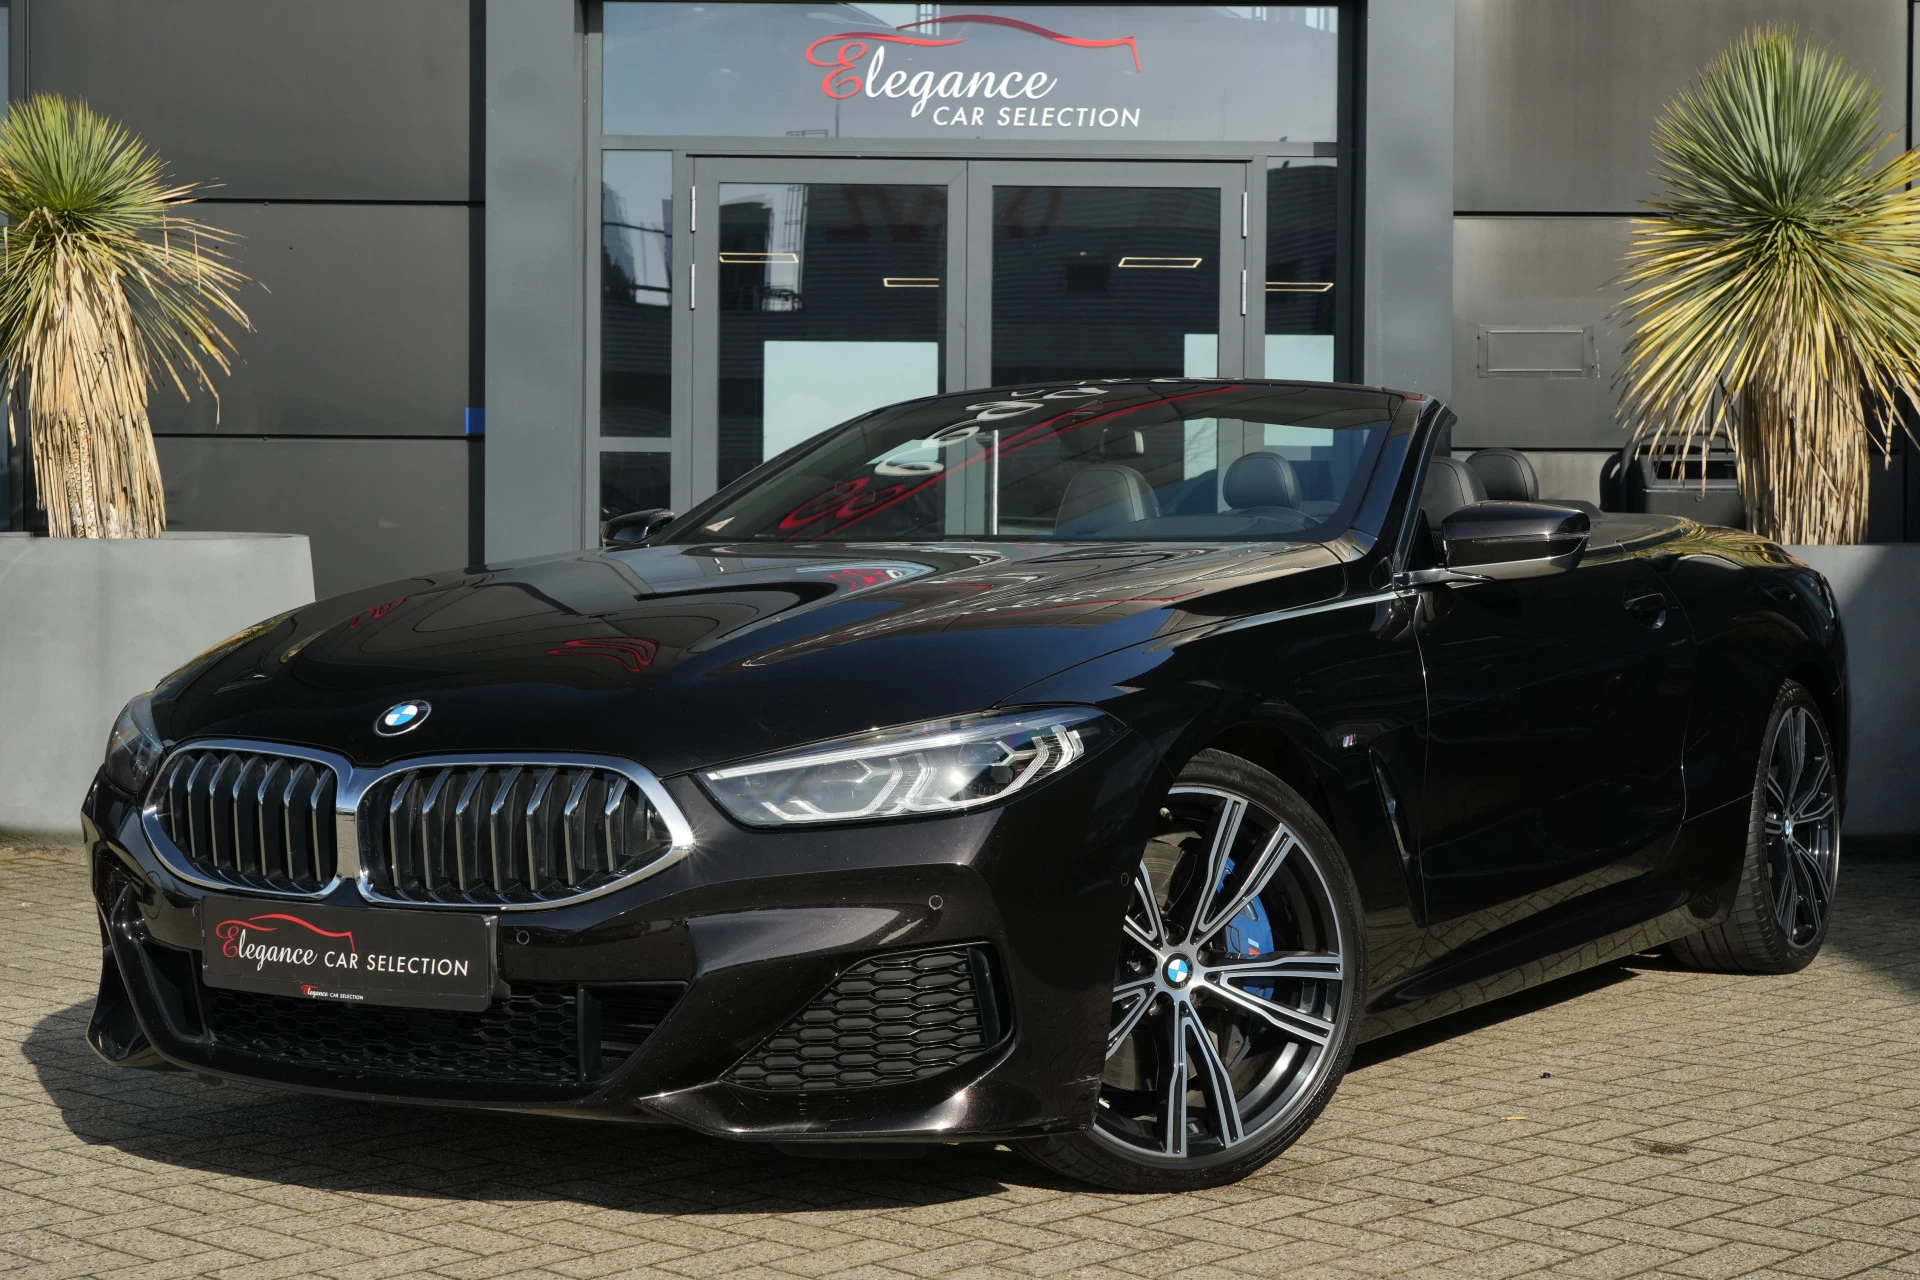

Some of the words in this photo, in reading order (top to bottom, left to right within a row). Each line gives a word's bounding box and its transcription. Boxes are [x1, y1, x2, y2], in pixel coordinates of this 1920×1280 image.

[805, 32, 1058, 119] Elegance
[933, 106, 985, 127] CAR
[997, 106, 1142, 128] SELECTION
[216, 919, 318, 971] Elegance
[324, 951, 359, 970] CAR
[366, 954, 469, 977] SELECTION
